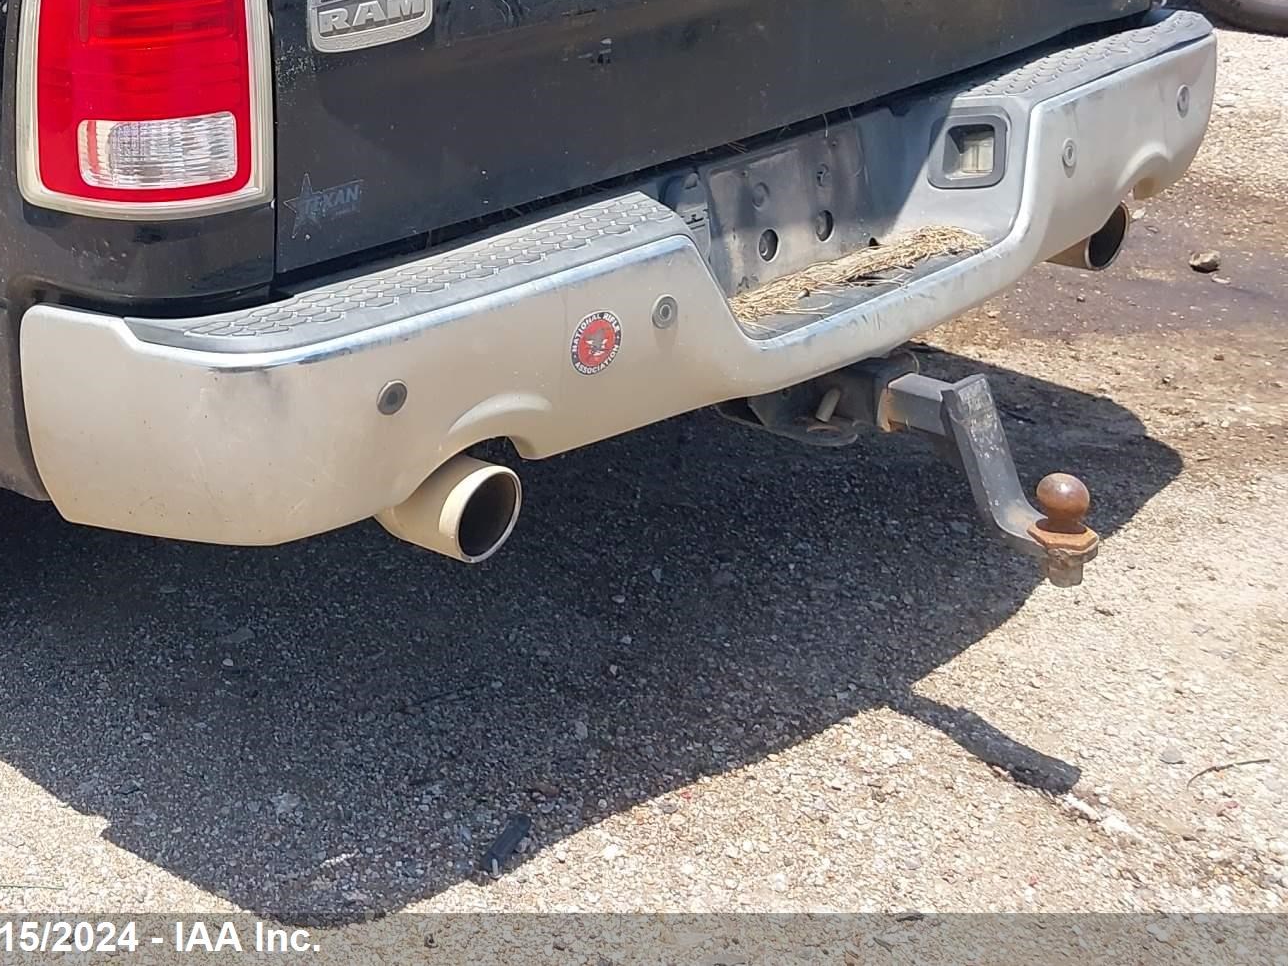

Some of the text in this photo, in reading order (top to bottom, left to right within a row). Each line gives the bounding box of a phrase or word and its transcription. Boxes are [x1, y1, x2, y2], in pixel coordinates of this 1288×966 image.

[571, 313, 621, 353] NATIONAL RIFLE
[574, 344, 620, 375] ASSOCIATION
